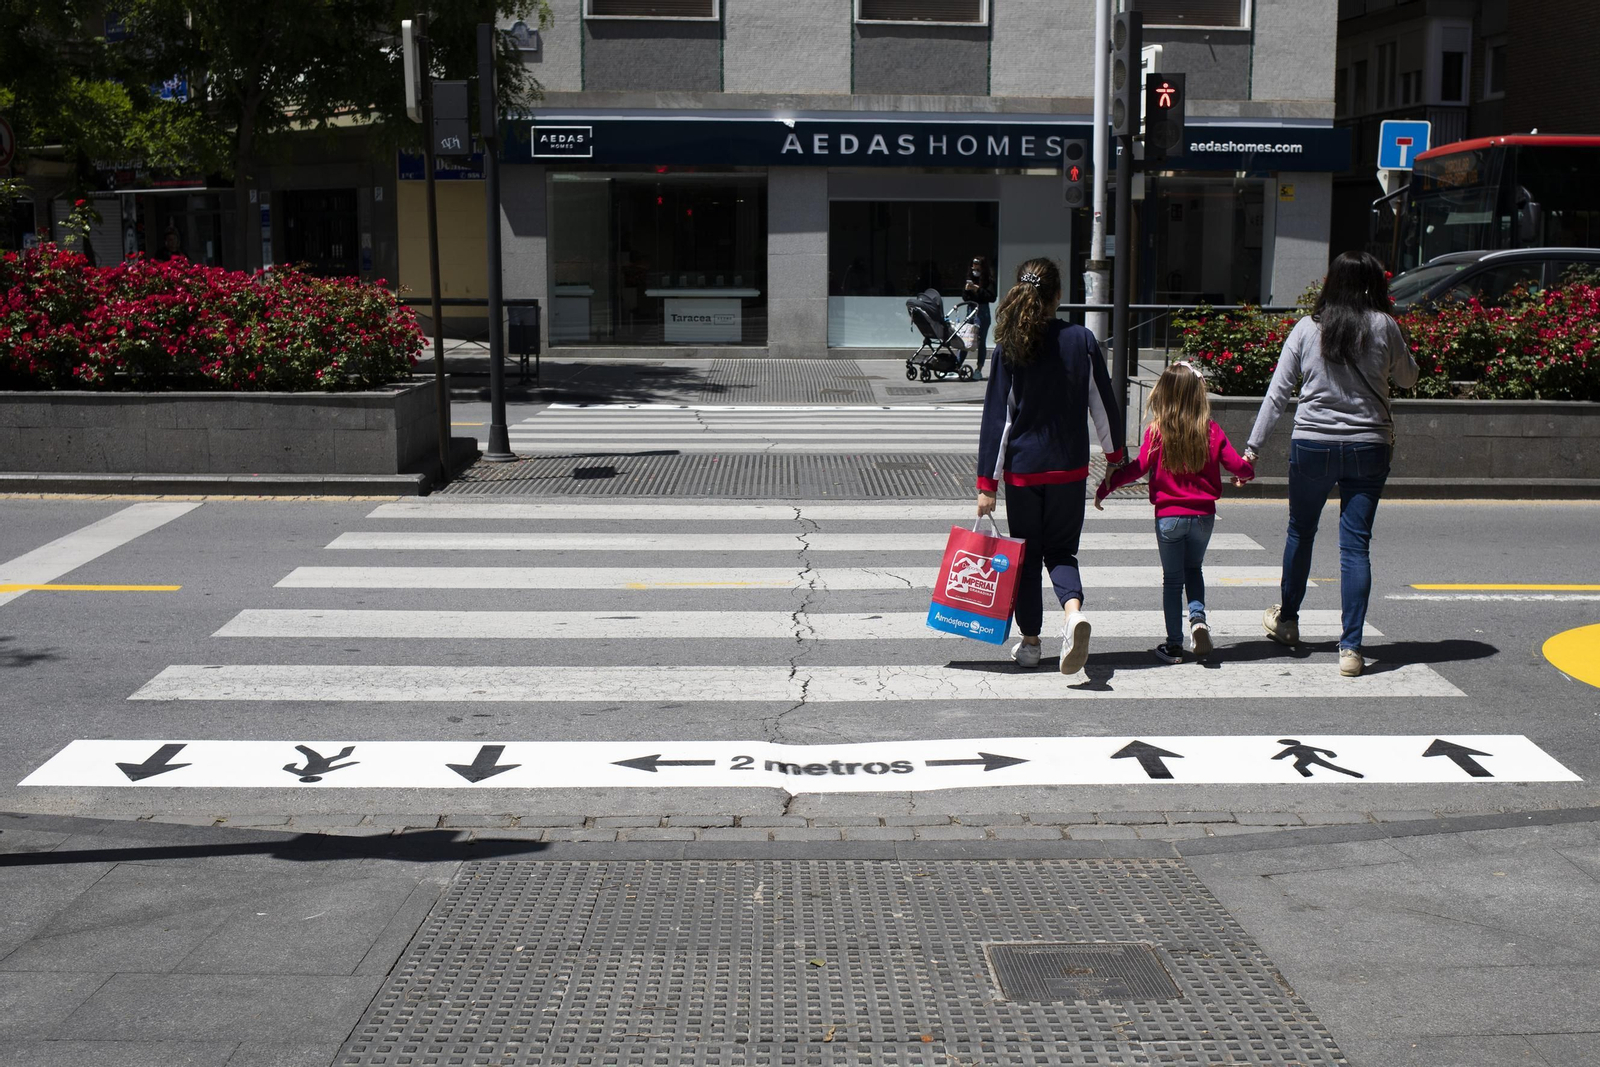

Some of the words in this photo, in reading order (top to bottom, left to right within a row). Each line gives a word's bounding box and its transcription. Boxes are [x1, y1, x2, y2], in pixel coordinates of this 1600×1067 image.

[540, 134, 584, 143] AEDAS
[1190, 140, 1303, 154] aedashomes.com
[671, 313, 712, 322] Taracea
[949, 572, 959, 583] LA
[962, 576, 994, 591] IMPERIAL
[729, 755, 755, 771] 2
[764, 757, 914, 776] metros
